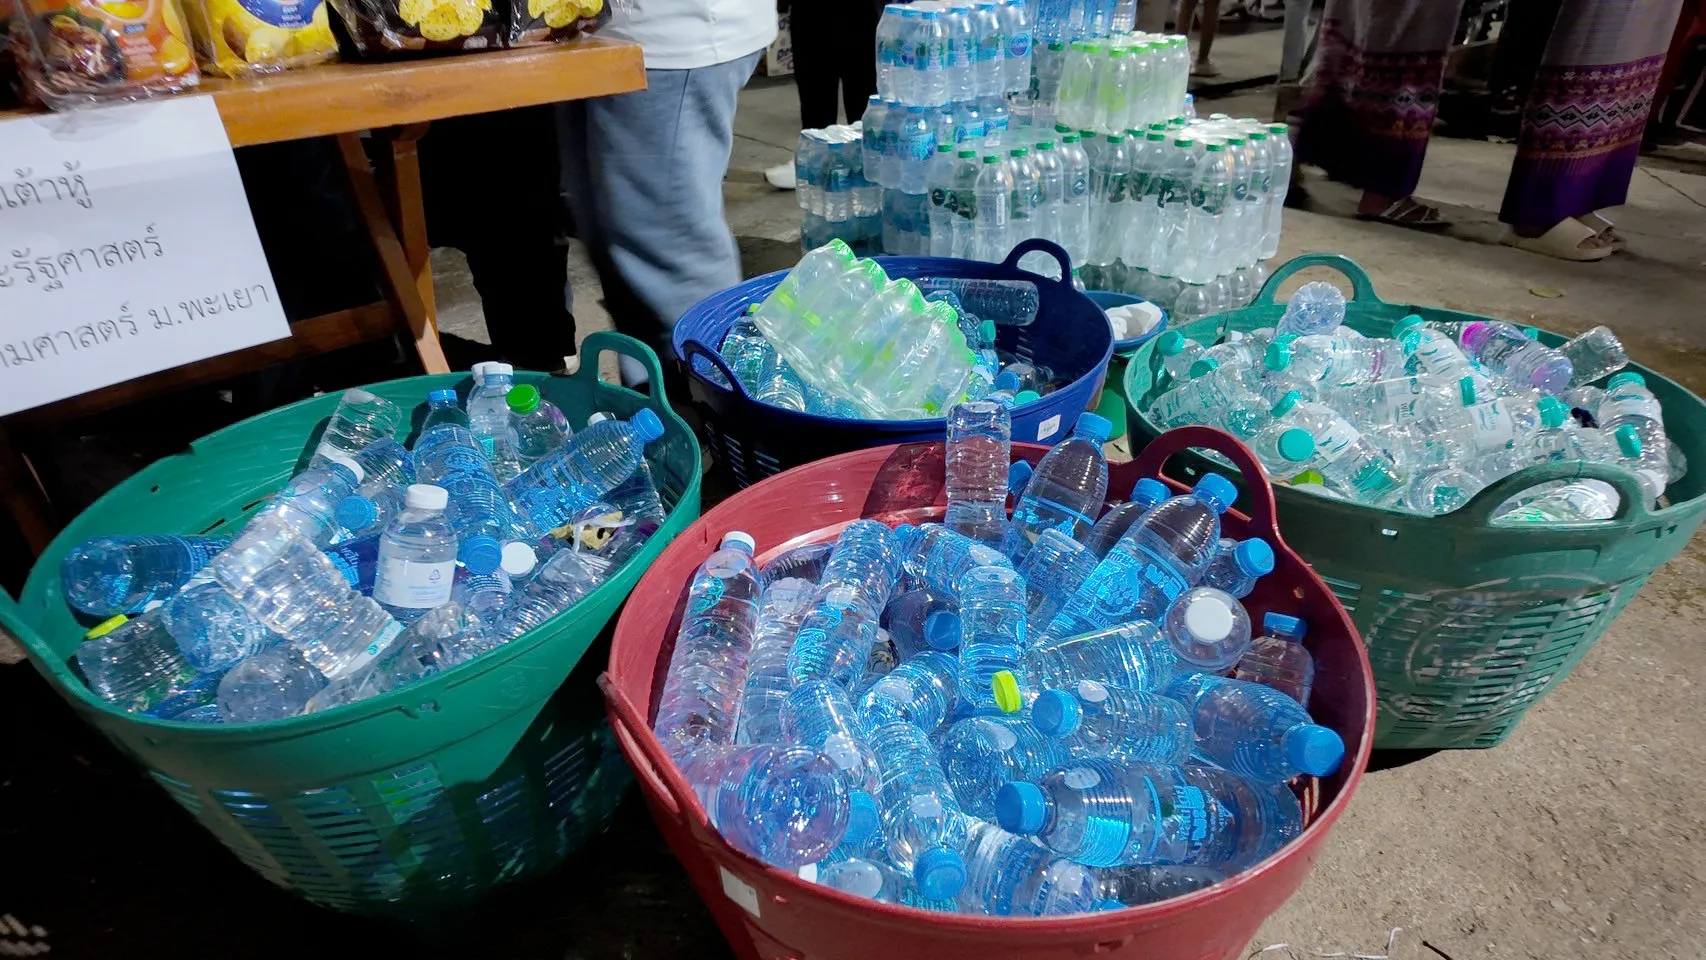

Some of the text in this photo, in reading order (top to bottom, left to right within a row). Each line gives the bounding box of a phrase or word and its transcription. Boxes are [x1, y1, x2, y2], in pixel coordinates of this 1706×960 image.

[0, 160, 93, 209] เต้าหู้
[149, 284, 269, 329] ม.พะเยา
